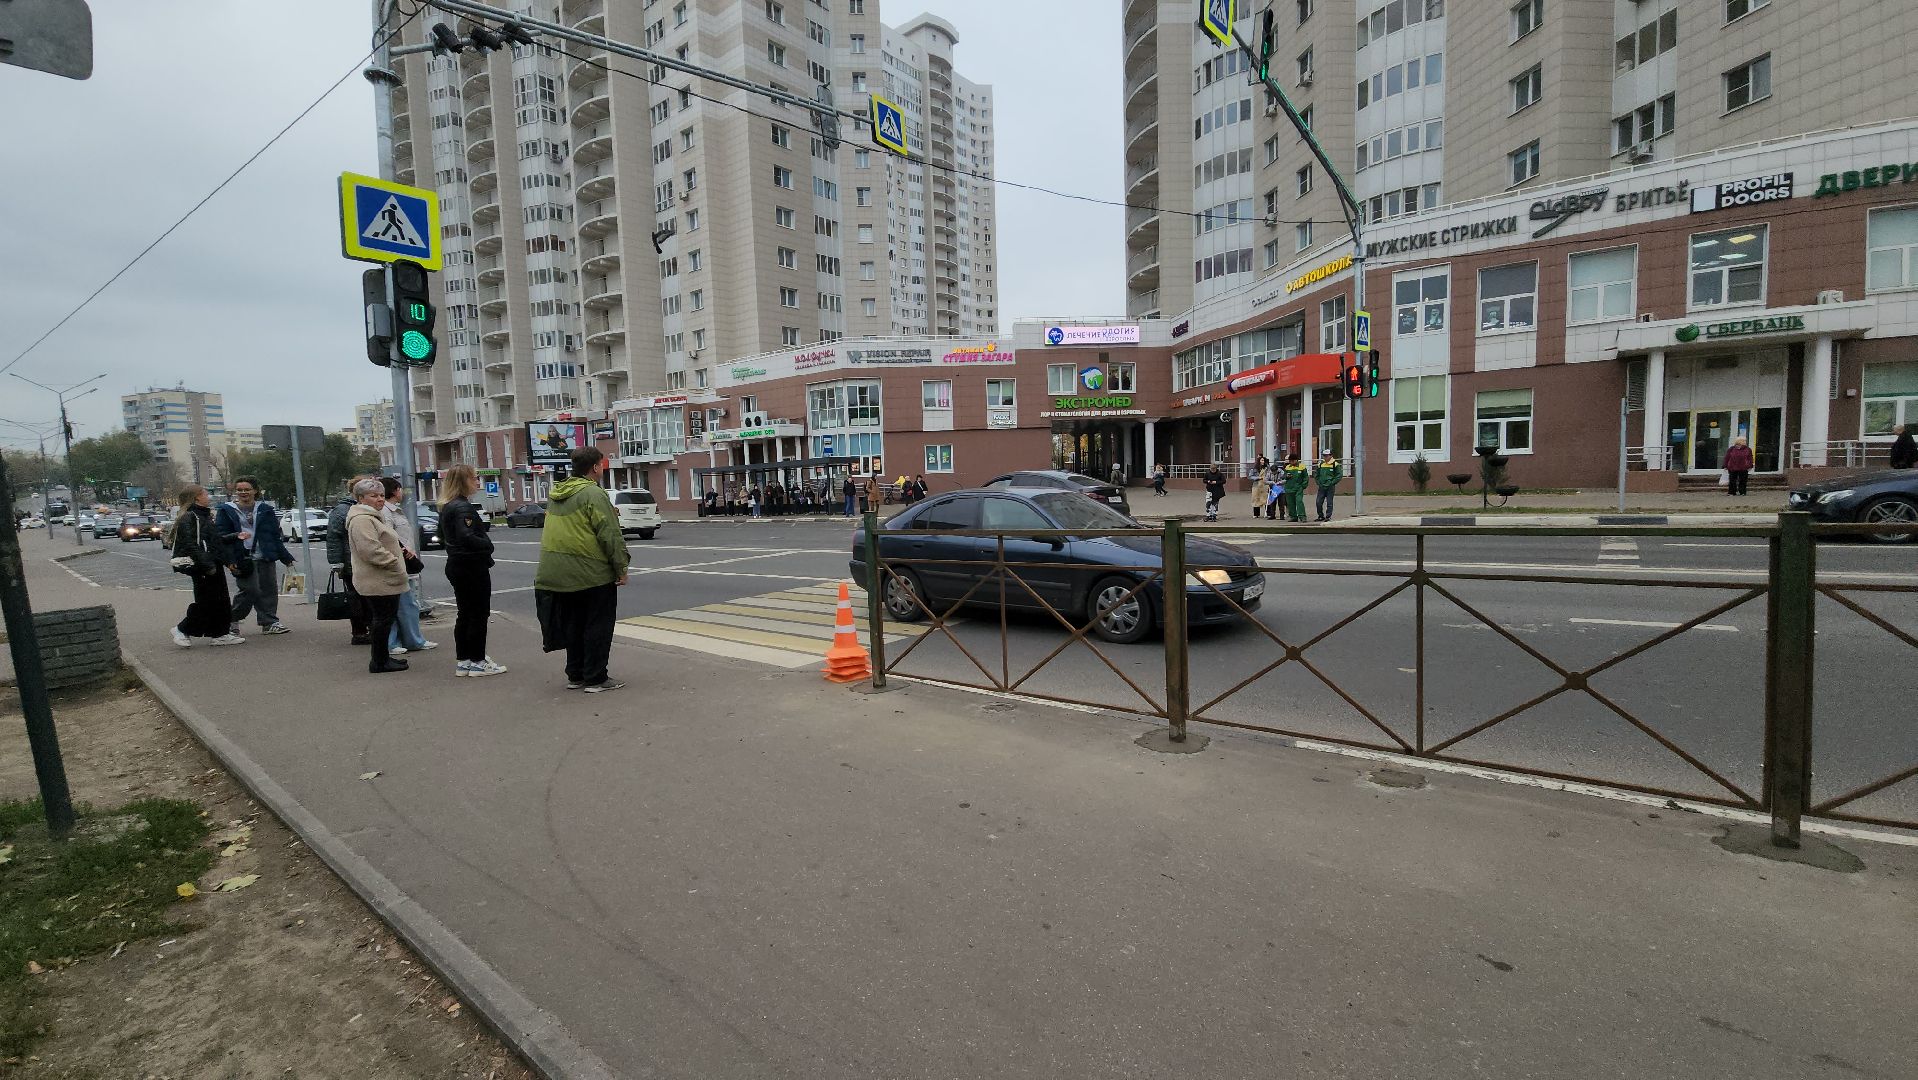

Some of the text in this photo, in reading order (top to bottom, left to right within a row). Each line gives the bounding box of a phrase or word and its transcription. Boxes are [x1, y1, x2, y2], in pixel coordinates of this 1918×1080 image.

[1615, 178, 1690, 213] БРИТЬЁ
[1721, 173, 1792, 196] PROFIL
[1721, 186, 1791, 208] DOORS
[1366, 215, 1518, 258] МУЖСКИЕ СТРИЖКИ
[1292, 253, 1354, 291] АВТОШКОЛА
[410, 303, 425, 320] 10
[1706, 314, 1805, 336] СБЕРБАНК
[866, 349, 932, 358] VISION REPAIR
